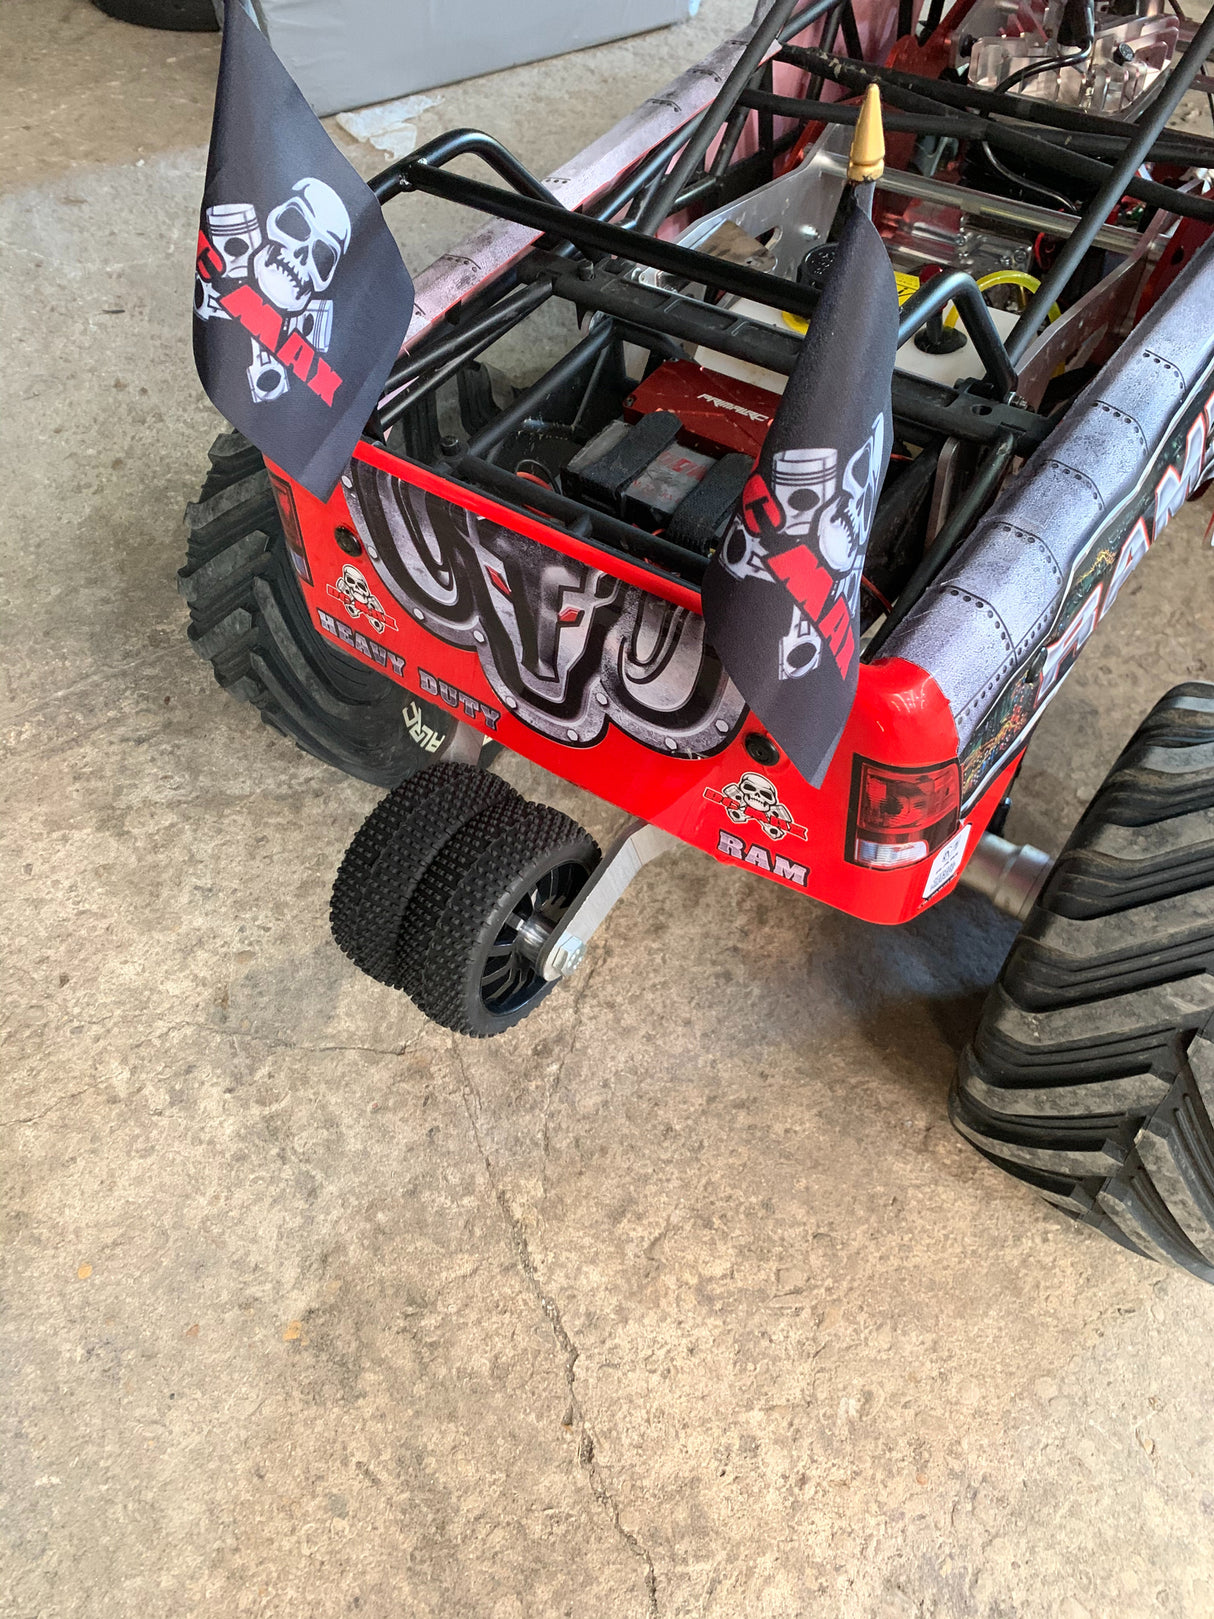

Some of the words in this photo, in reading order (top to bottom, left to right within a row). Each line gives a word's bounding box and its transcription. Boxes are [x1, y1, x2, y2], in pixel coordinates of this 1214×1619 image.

[219, 284, 343, 408] MAX
[1033, 388, 1214, 708] RAM
[316, 607, 406, 678] HEAVY
[417, 667, 501, 731] DUTY
[402, 701, 446, 753] ALRC
[717, 829, 810, 887] RAM
